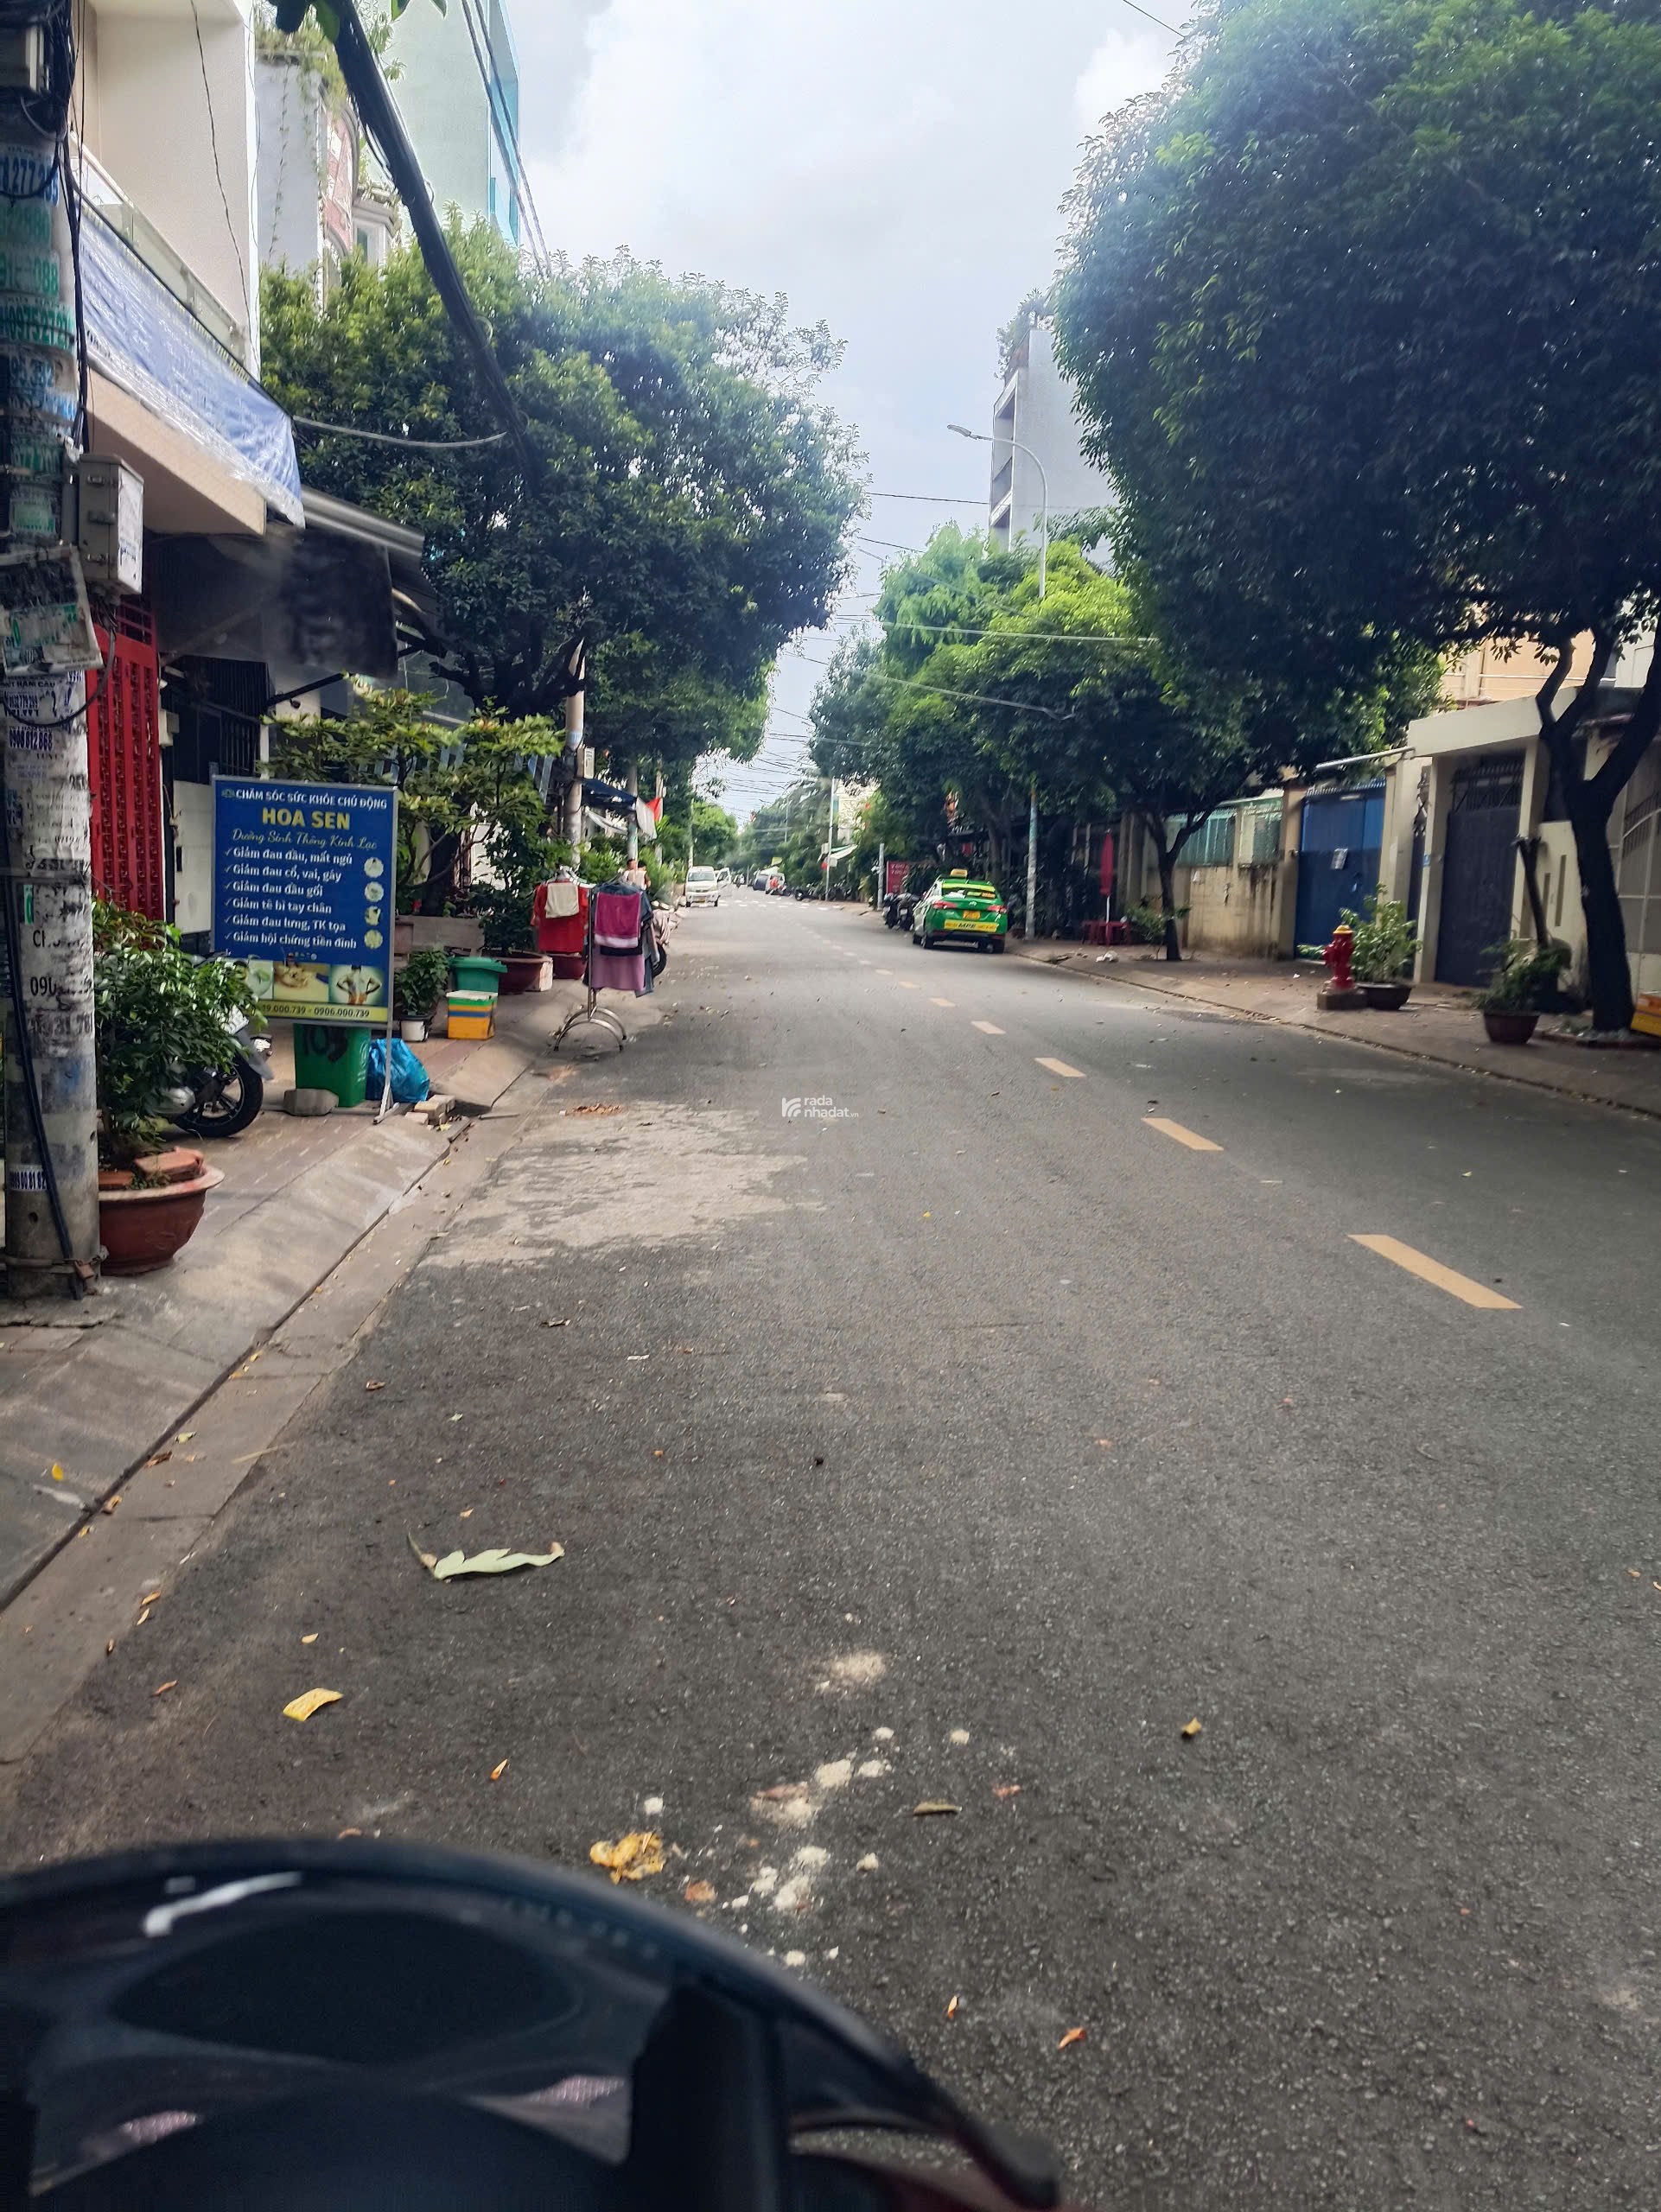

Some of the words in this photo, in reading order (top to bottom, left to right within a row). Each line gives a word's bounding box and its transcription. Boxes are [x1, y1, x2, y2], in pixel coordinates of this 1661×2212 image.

[236, 788, 264, 800] CHĂM
[266, 790, 285, 802] SÓC
[288, 791, 307, 804] SỨC
[360, 796, 387, 811] ĐỘNG
[263, 807, 305, 827] HOA
[311, 810, 350, 830] SEN
[268, 830, 292, 843] Sinh
[296, 831, 326, 849] Thông
[330, 835, 353, 848] Kinh
[357, 836, 378, 851] Lạc
[233, 846, 259, 860] Giảm
[263, 849, 282, 860] đau
[310, 850, 330, 863] mất
[333, 853, 353, 867] ngủ
[232, 863, 259, 876] Giảm
[263, 866, 282, 877] đau
[302, 868, 321, 881] vai,
[322, 869, 342, 883] gáy
[232, 880, 259, 893] Giảm
[262, 882, 282, 893] đau
[284, 882, 304, 895] đầu
[307, 884, 323, 898] gối
[232, 897, 259, 910] Giảm
[262, 899, 273, 910] tê
[275, 899, 285, 911] bì
[288, 901, 305, 915] tay
[307, 902, 332, 914] chân
[232, 913, 259, 926] Giảm
[261, 916, 281, 927] đau
[313, 919, 327, 930] TK
[328, 921, 346, 934] tọa
[232, 931, 259, 944] Giảm
[261, 932, 277, 945] hội
[279, 933, 310, 948] chứng
[312, 934, 332, 947] tiền
[334, 937, 357, 949] đình
